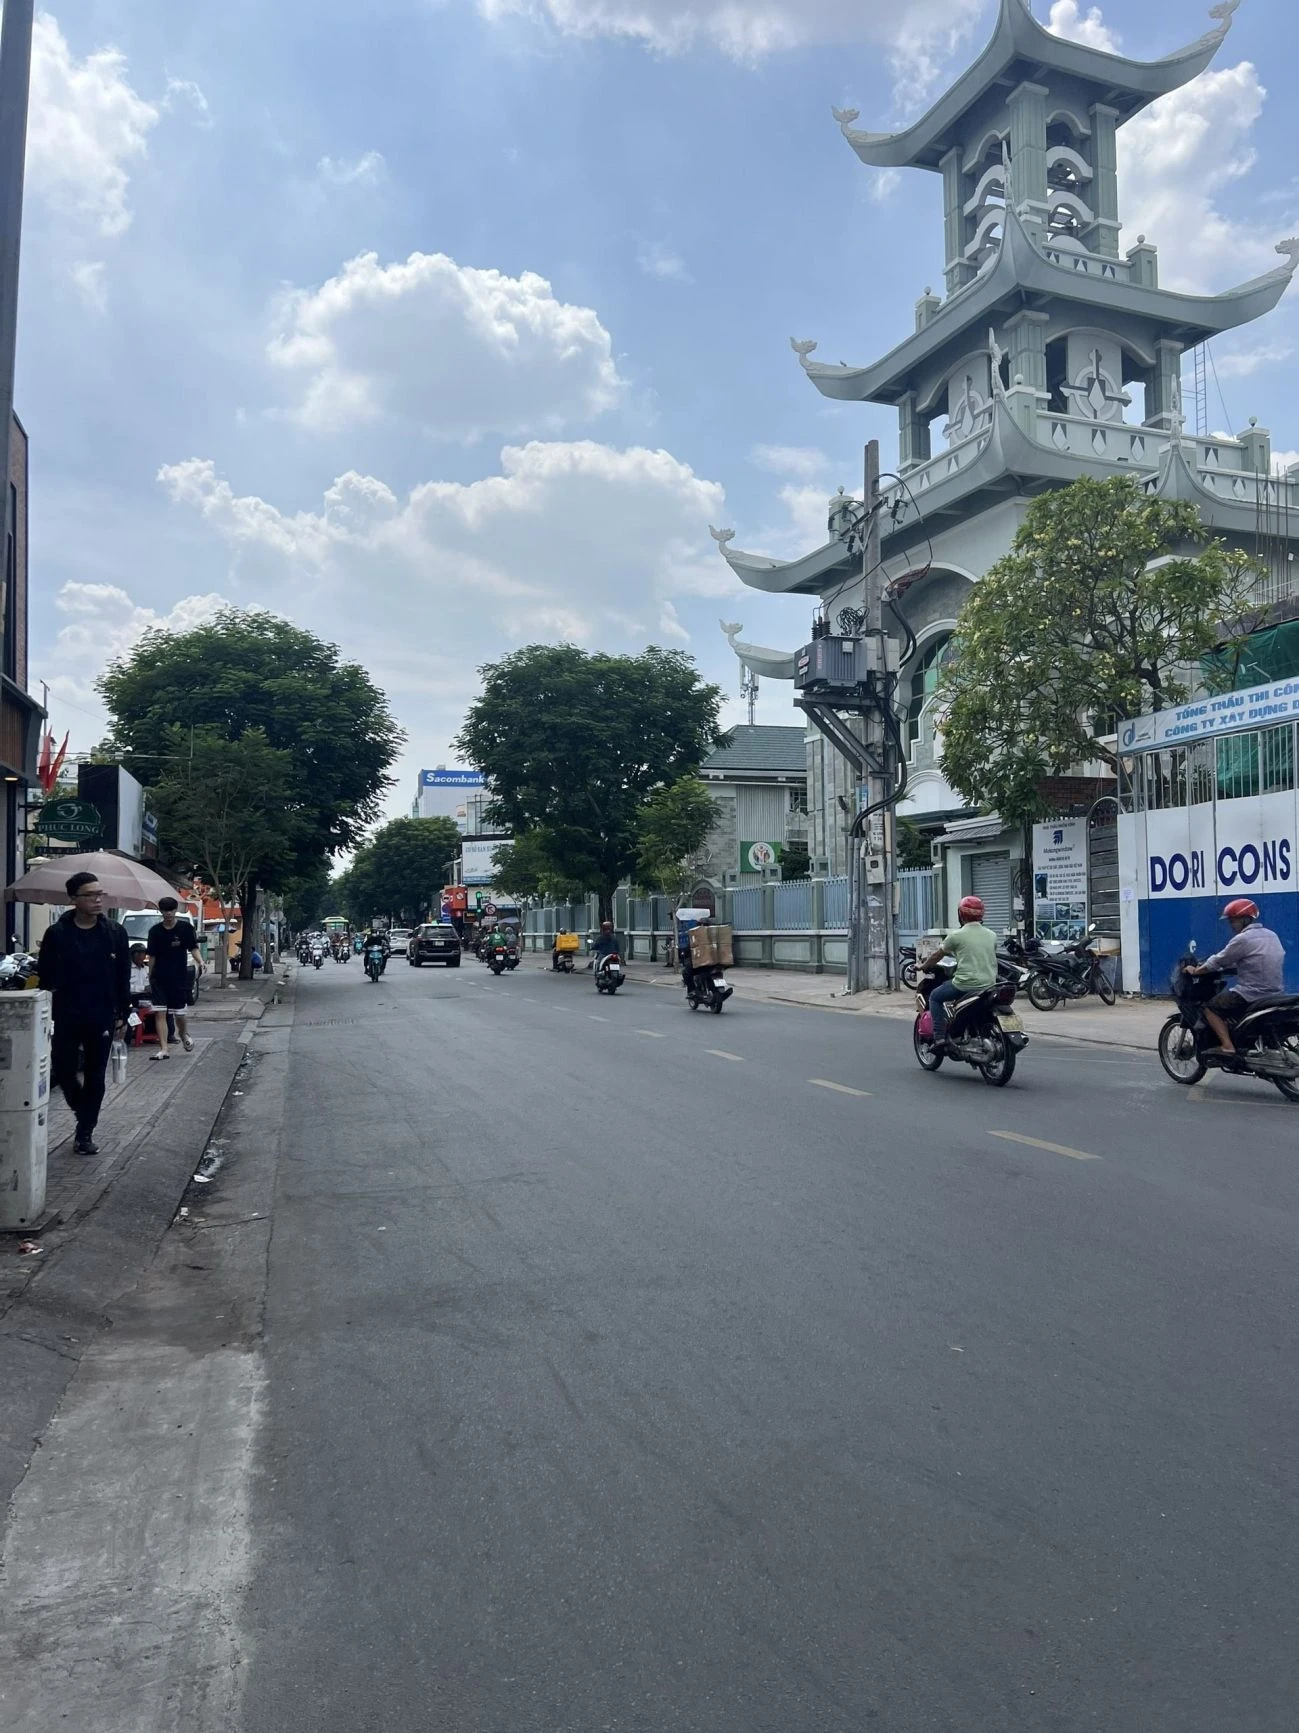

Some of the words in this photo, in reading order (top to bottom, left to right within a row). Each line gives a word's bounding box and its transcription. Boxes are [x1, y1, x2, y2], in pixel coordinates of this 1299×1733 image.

[1247, 691, 1270, 704] THI
[1165, 722, 1198, 738] CÔNG
[1201, 718, 1216, 730] TY
[1219, 711, 1246, 726] XÂY
[1249, 702, 1288, 720] DỰNG
[426, 772, 485, 784] Sacombank
[71, 824, 99, 834] LONG
[1149, 850, 1206, 893] DORI
[1217, 838, 1291, 887] CONS
